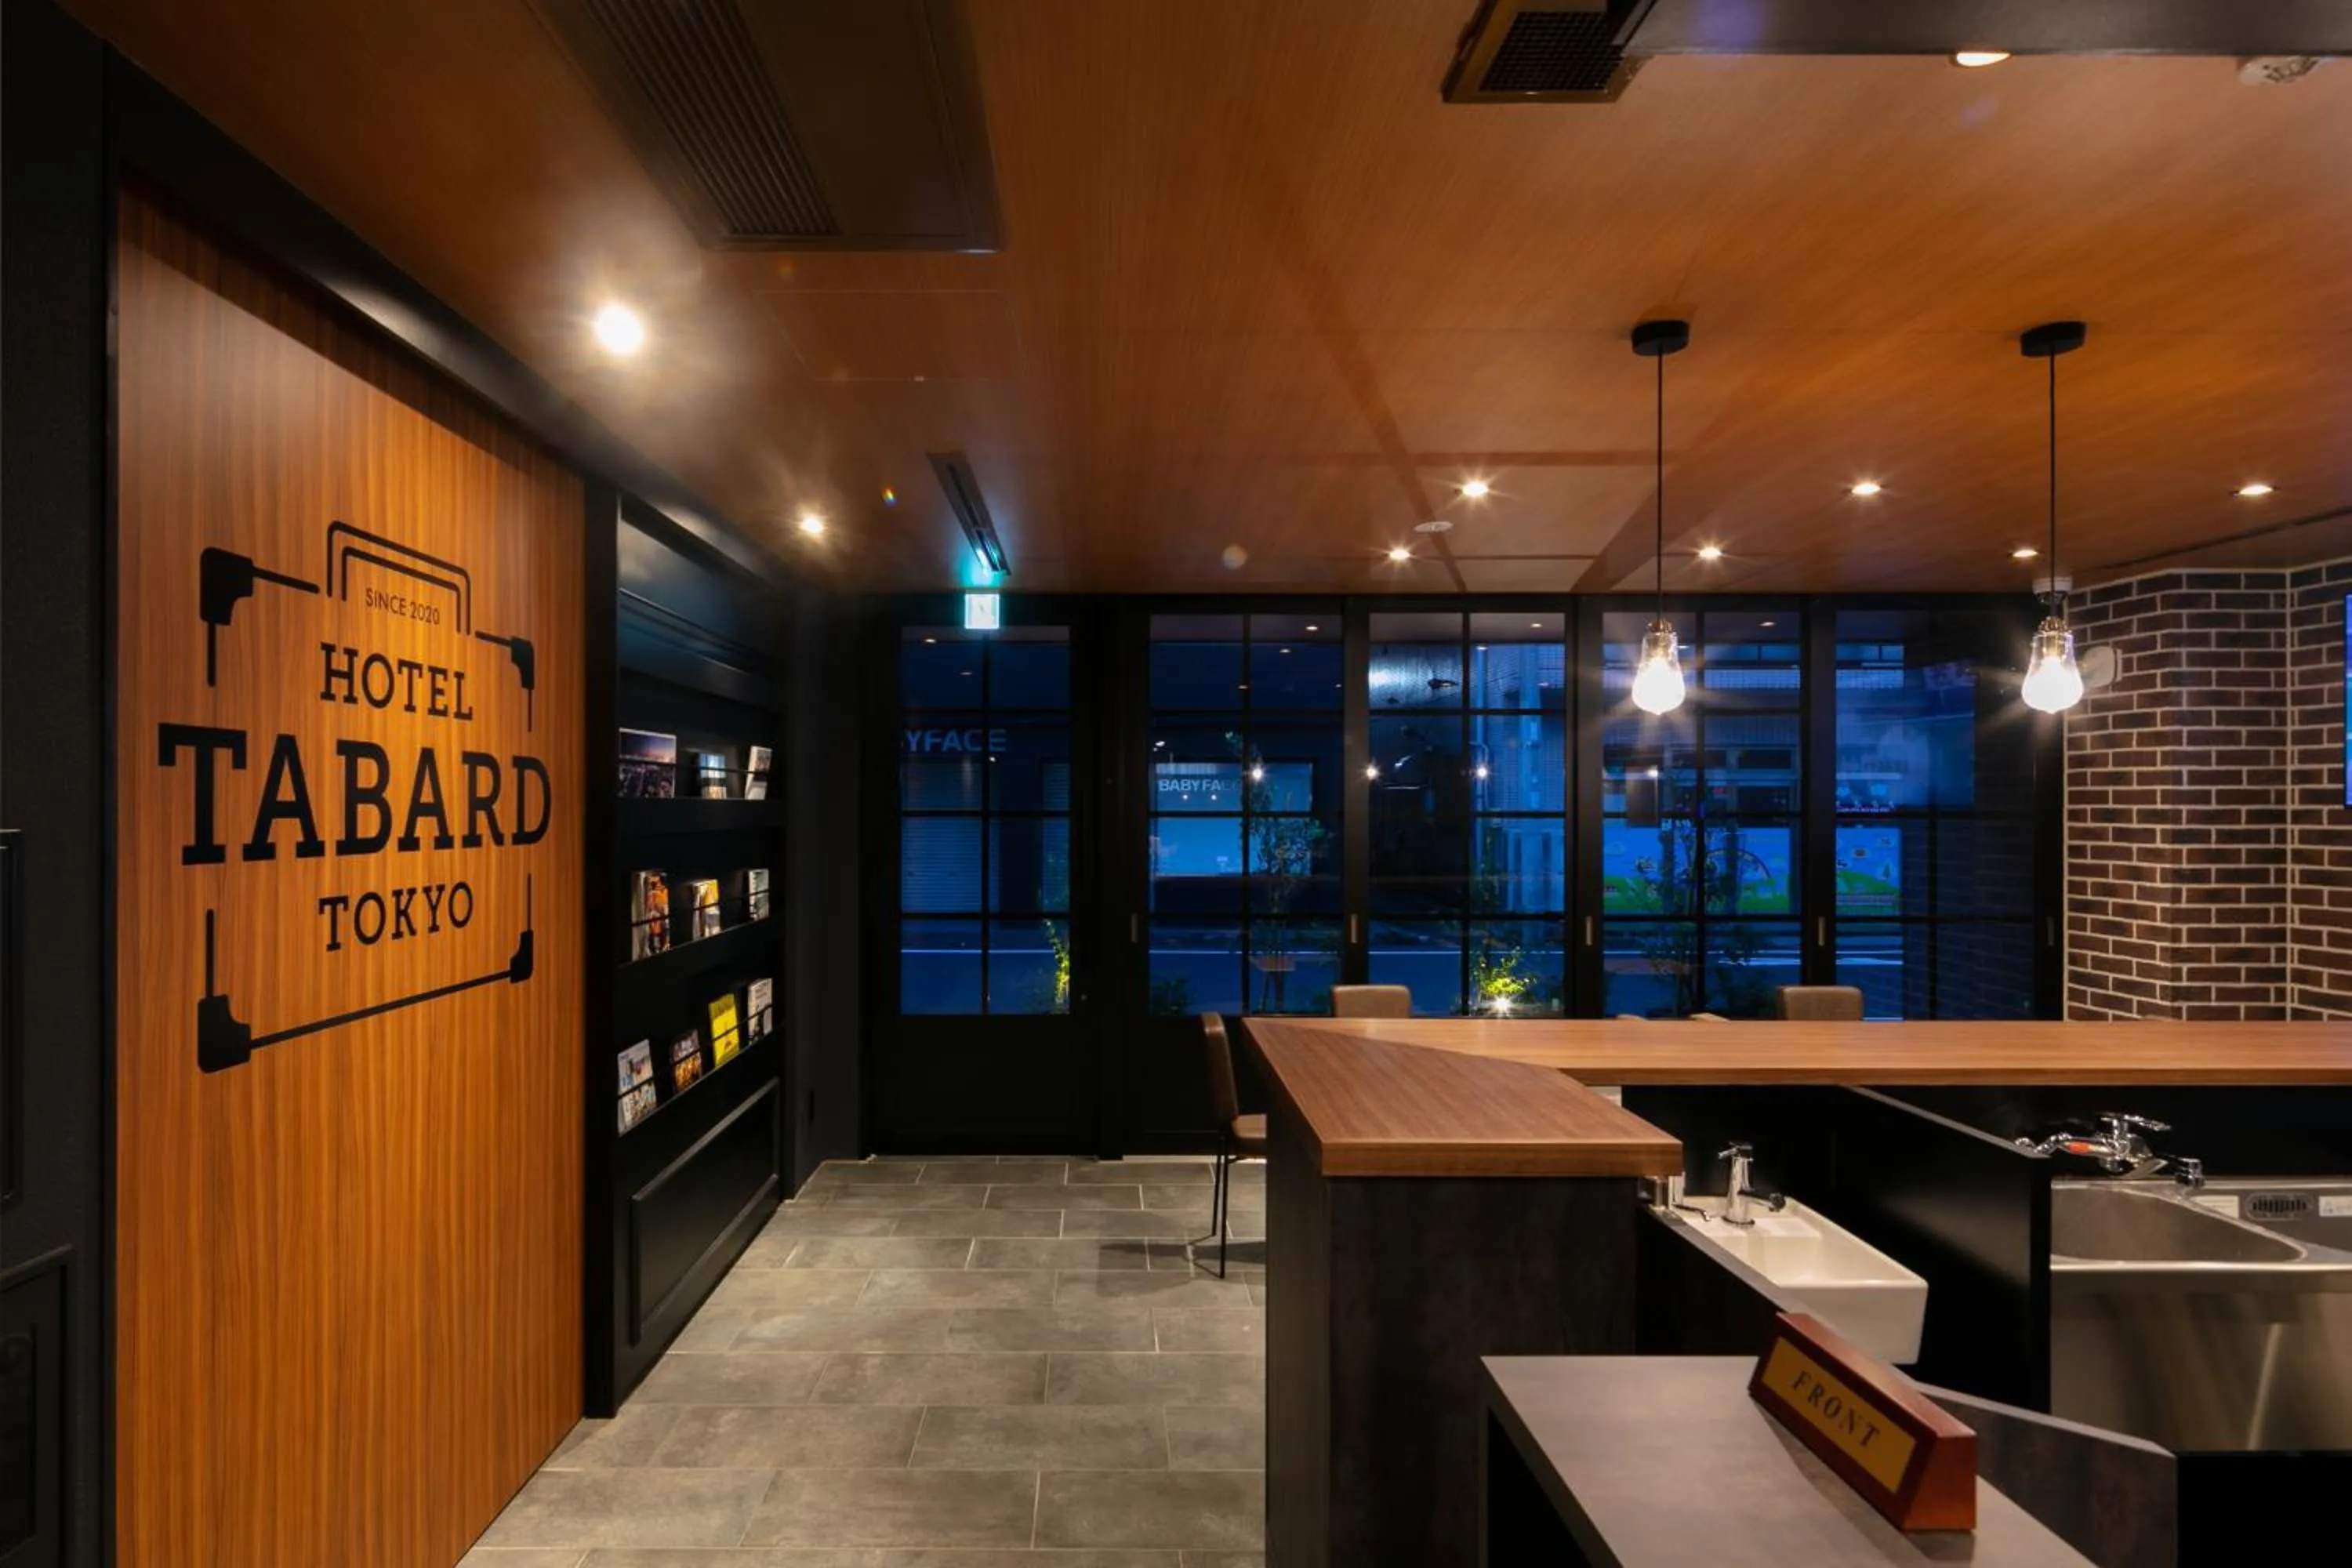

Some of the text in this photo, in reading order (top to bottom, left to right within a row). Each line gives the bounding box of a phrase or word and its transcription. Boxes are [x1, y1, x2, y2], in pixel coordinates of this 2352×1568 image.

[365, 586, 440, 625] SINCE 2020
[320, 641, 474, 721] HOTEL
[158, 722, 552, 866] TABARD
[319, 881, 474, 952] TOKYO
[1791, 1370, 1880, 1447] FRONT
